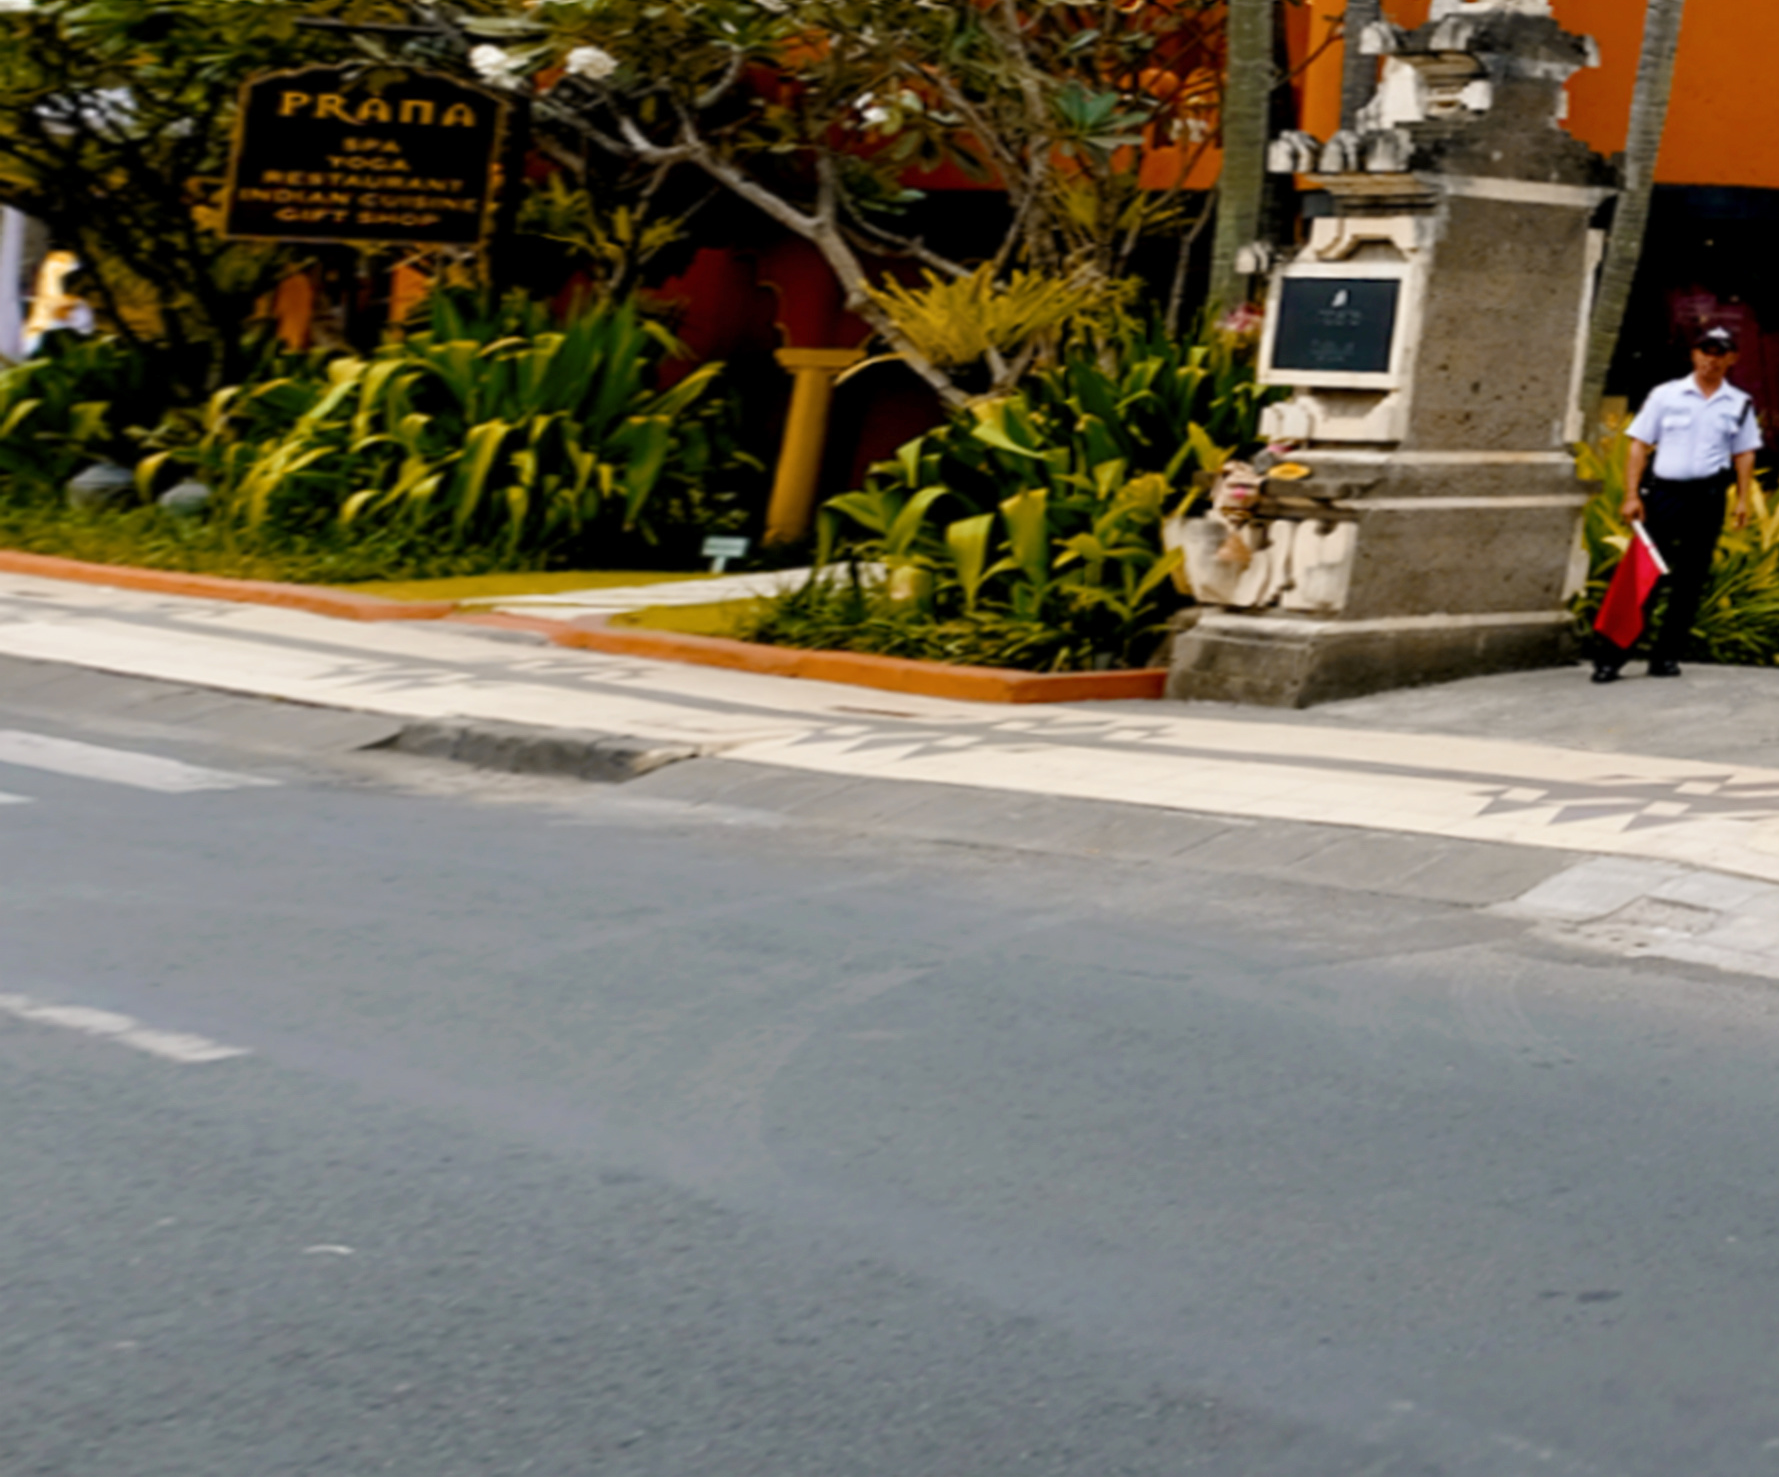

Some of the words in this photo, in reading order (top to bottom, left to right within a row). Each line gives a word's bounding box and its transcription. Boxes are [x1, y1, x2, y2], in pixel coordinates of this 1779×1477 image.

[277, 90, 476, 127] PRANA
[342, 137, 402, 153] SPA
[326, 155, 412, 172] YOGA
[261, 169, 463, 192] RESTAURANT
[239, 187, 349, 206] INDIAN
[356, 191, 476, 212] CUISINE
[273, 206, 349, 223] GIFT
[356, 210, 441, 227] SHOP
